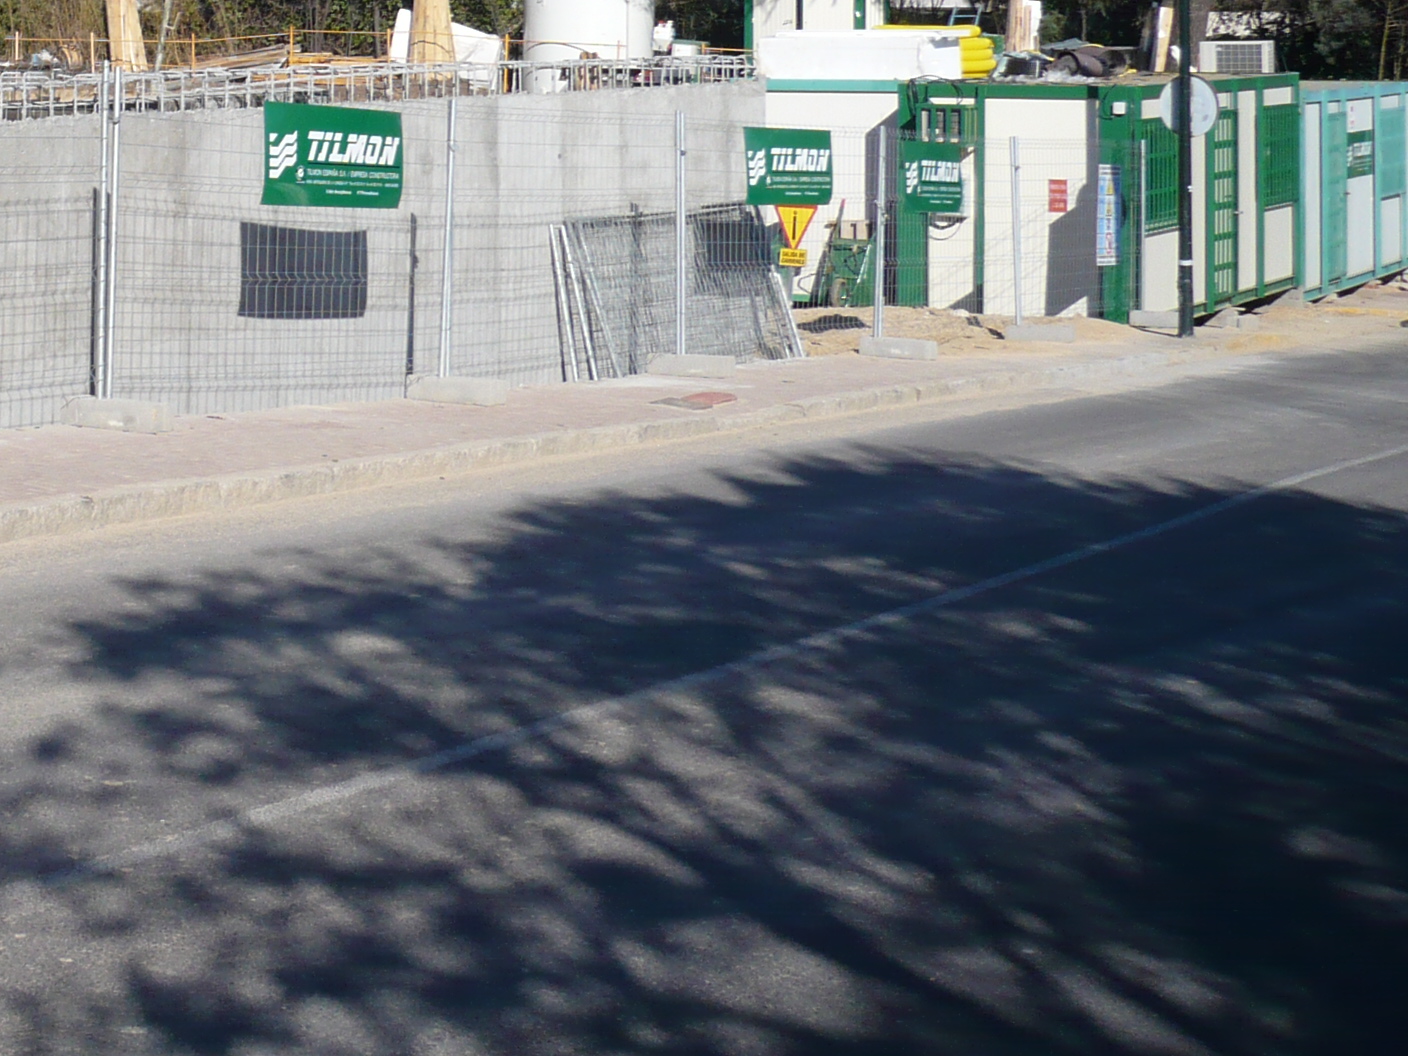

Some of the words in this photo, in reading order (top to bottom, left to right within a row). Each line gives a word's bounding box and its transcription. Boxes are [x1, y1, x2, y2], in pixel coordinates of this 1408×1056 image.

[306, 130, 400, 166] TILMON
[770, 147, 830, 172] TILMON
[921, 159, 960, 183] TILMON
